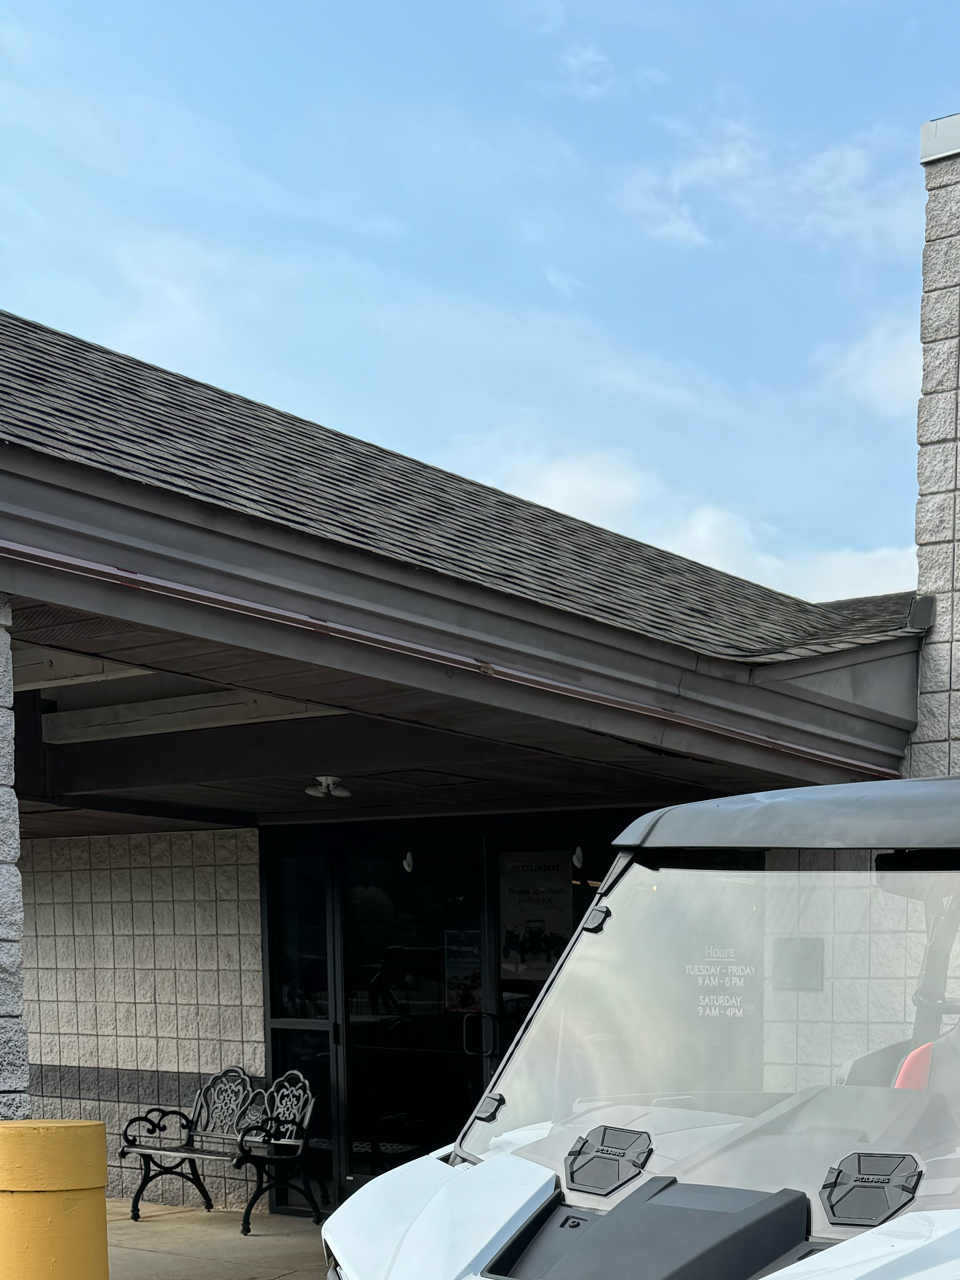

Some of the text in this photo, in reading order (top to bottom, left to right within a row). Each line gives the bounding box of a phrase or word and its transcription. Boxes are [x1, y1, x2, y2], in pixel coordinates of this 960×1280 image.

[704, 946, 735, 958] Hours
[685, 965, 721, 975] TUESDAY
[728, 965, 755, 976] FRIDAY
[698, 976, 703, 986] 9
[704, 976, 719, 987] AM
[725, 976, 730, 987] 6
[732, 977, 744, 987] PM
[699, 995, 742, 1007] SATURDAY
[698, 1006, 703, 1016] 9
[704, 1006, 719, 1017] AM
[726, 1007, 743, 1018] 4PM
